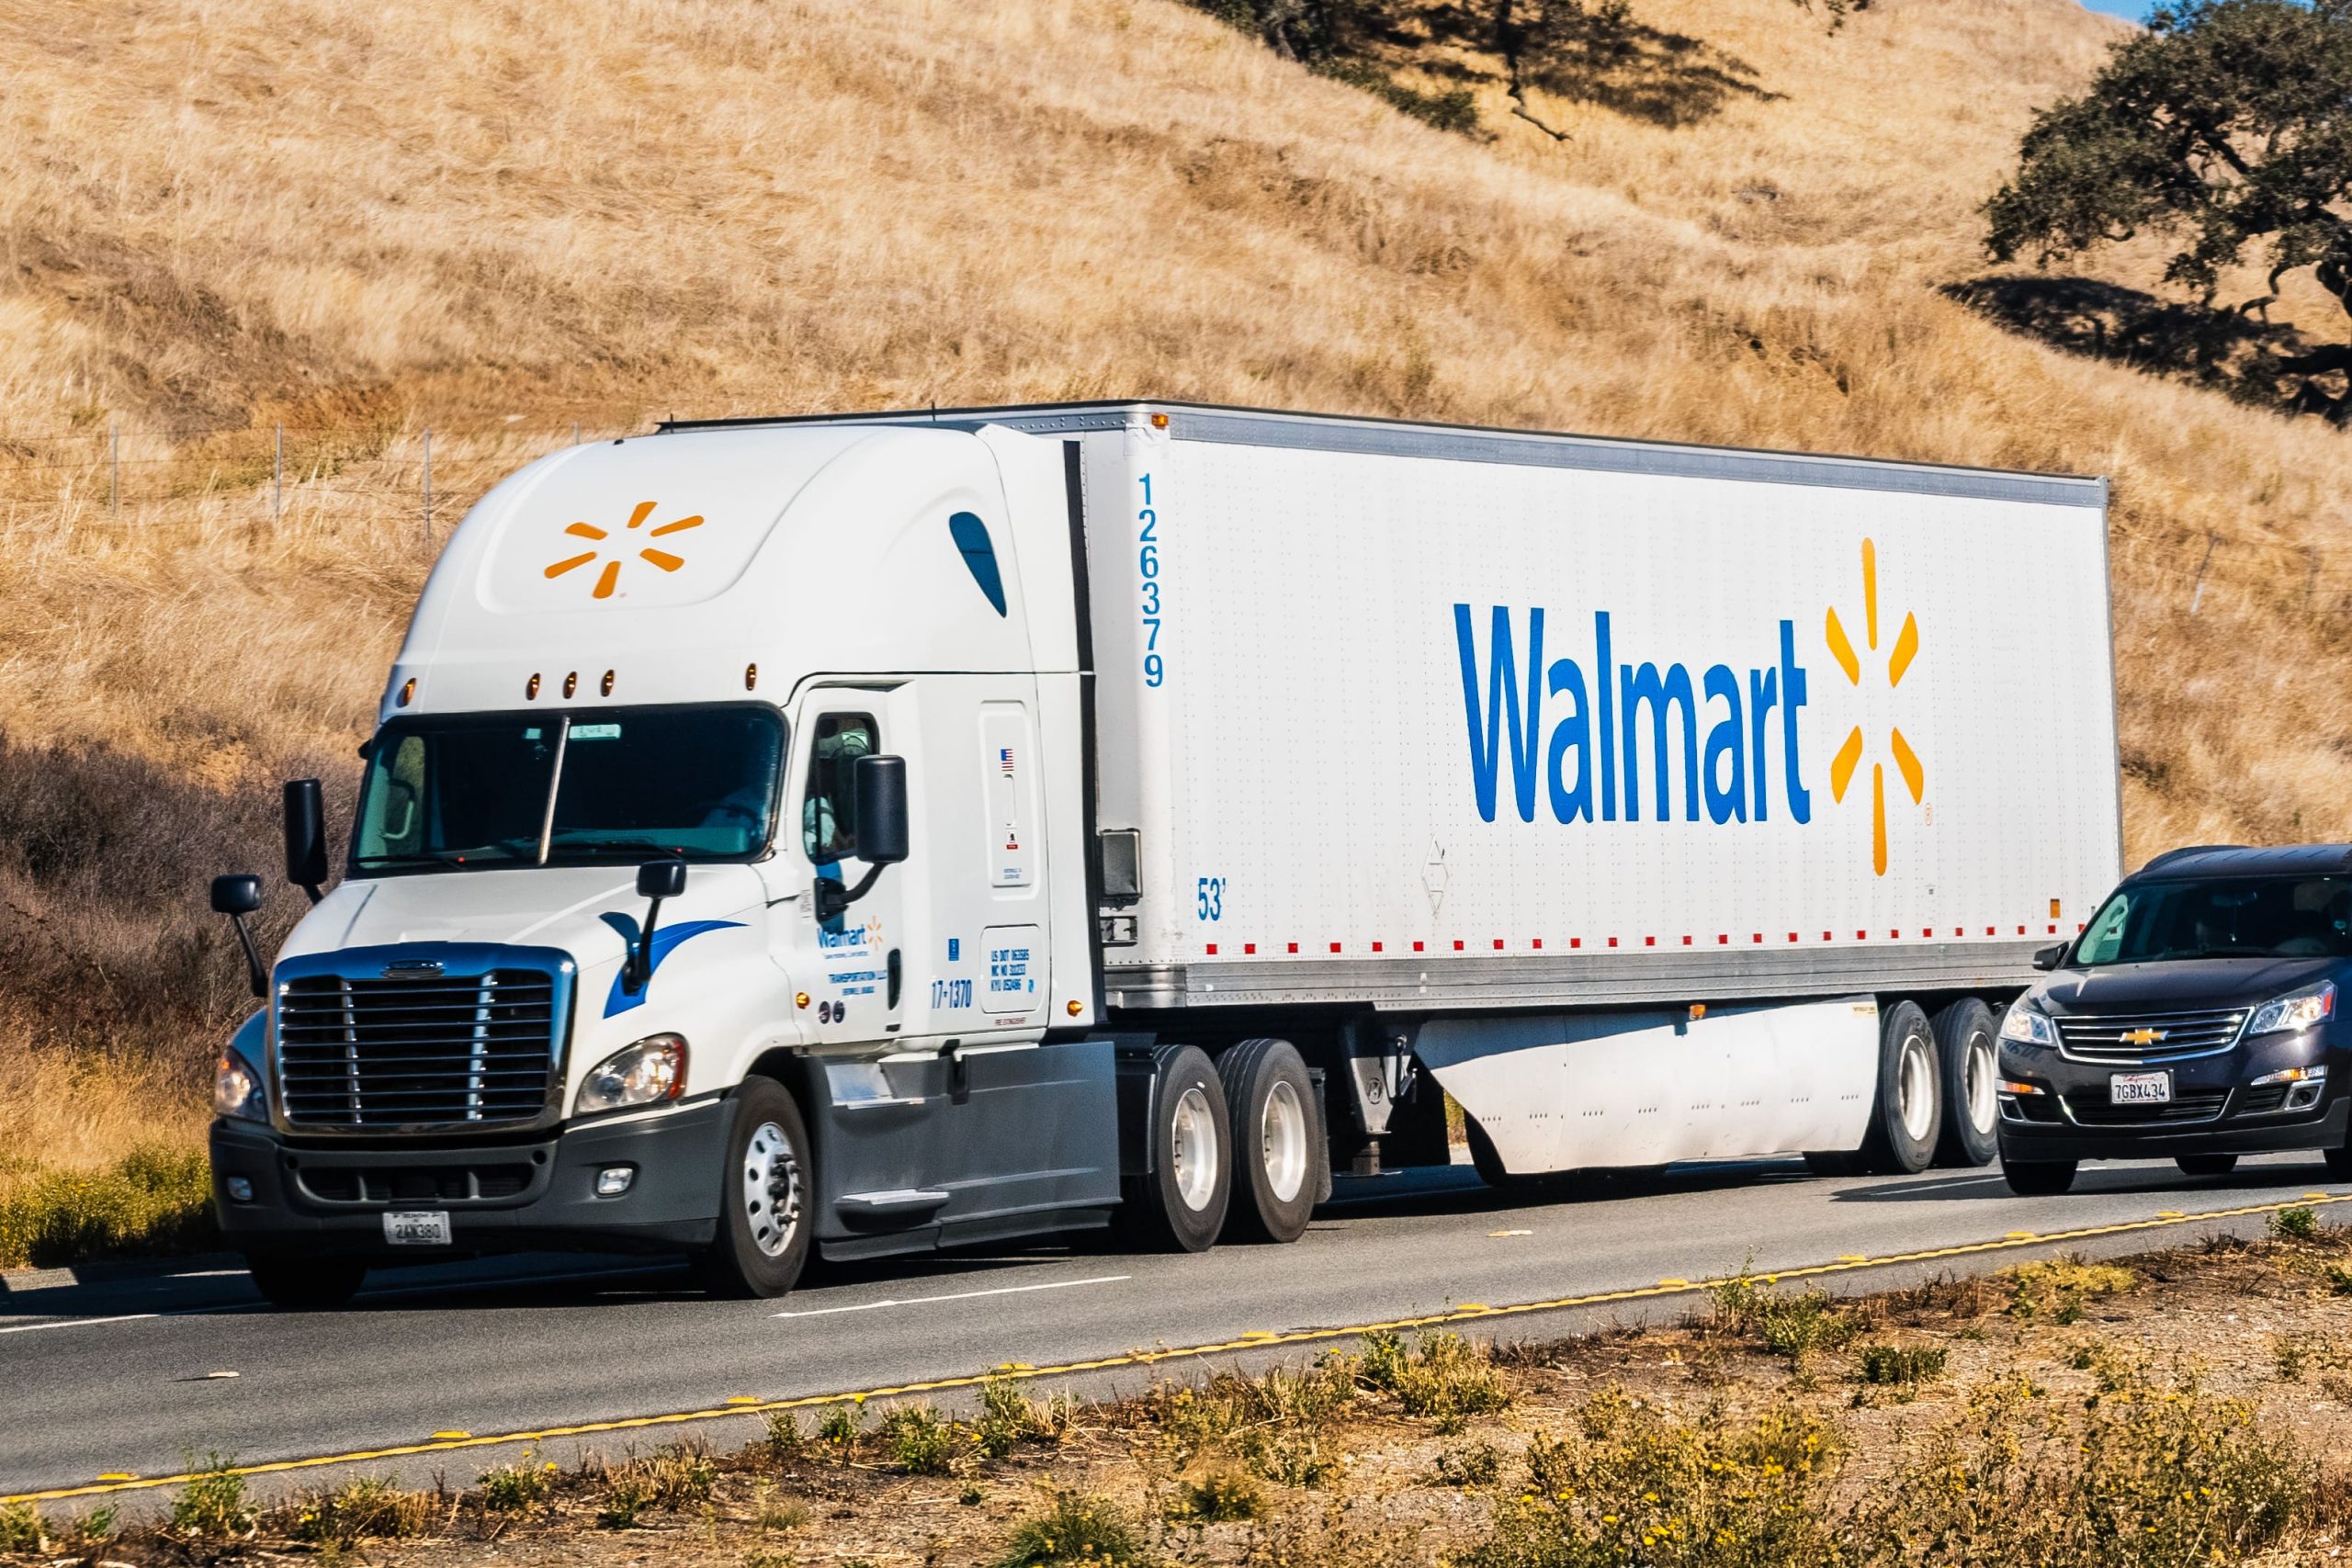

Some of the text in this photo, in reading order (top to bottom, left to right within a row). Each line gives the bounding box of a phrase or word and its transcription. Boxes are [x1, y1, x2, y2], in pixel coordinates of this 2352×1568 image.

[1138, 473, 1164, 688] 126379
[1453, 603, 1811, 825] Walmart
[817, 924, 866, 948] Walmart
[932, 979, 972, 1009] 17-1370
[2115, 1083, 2165, 1100] 7GBX434
